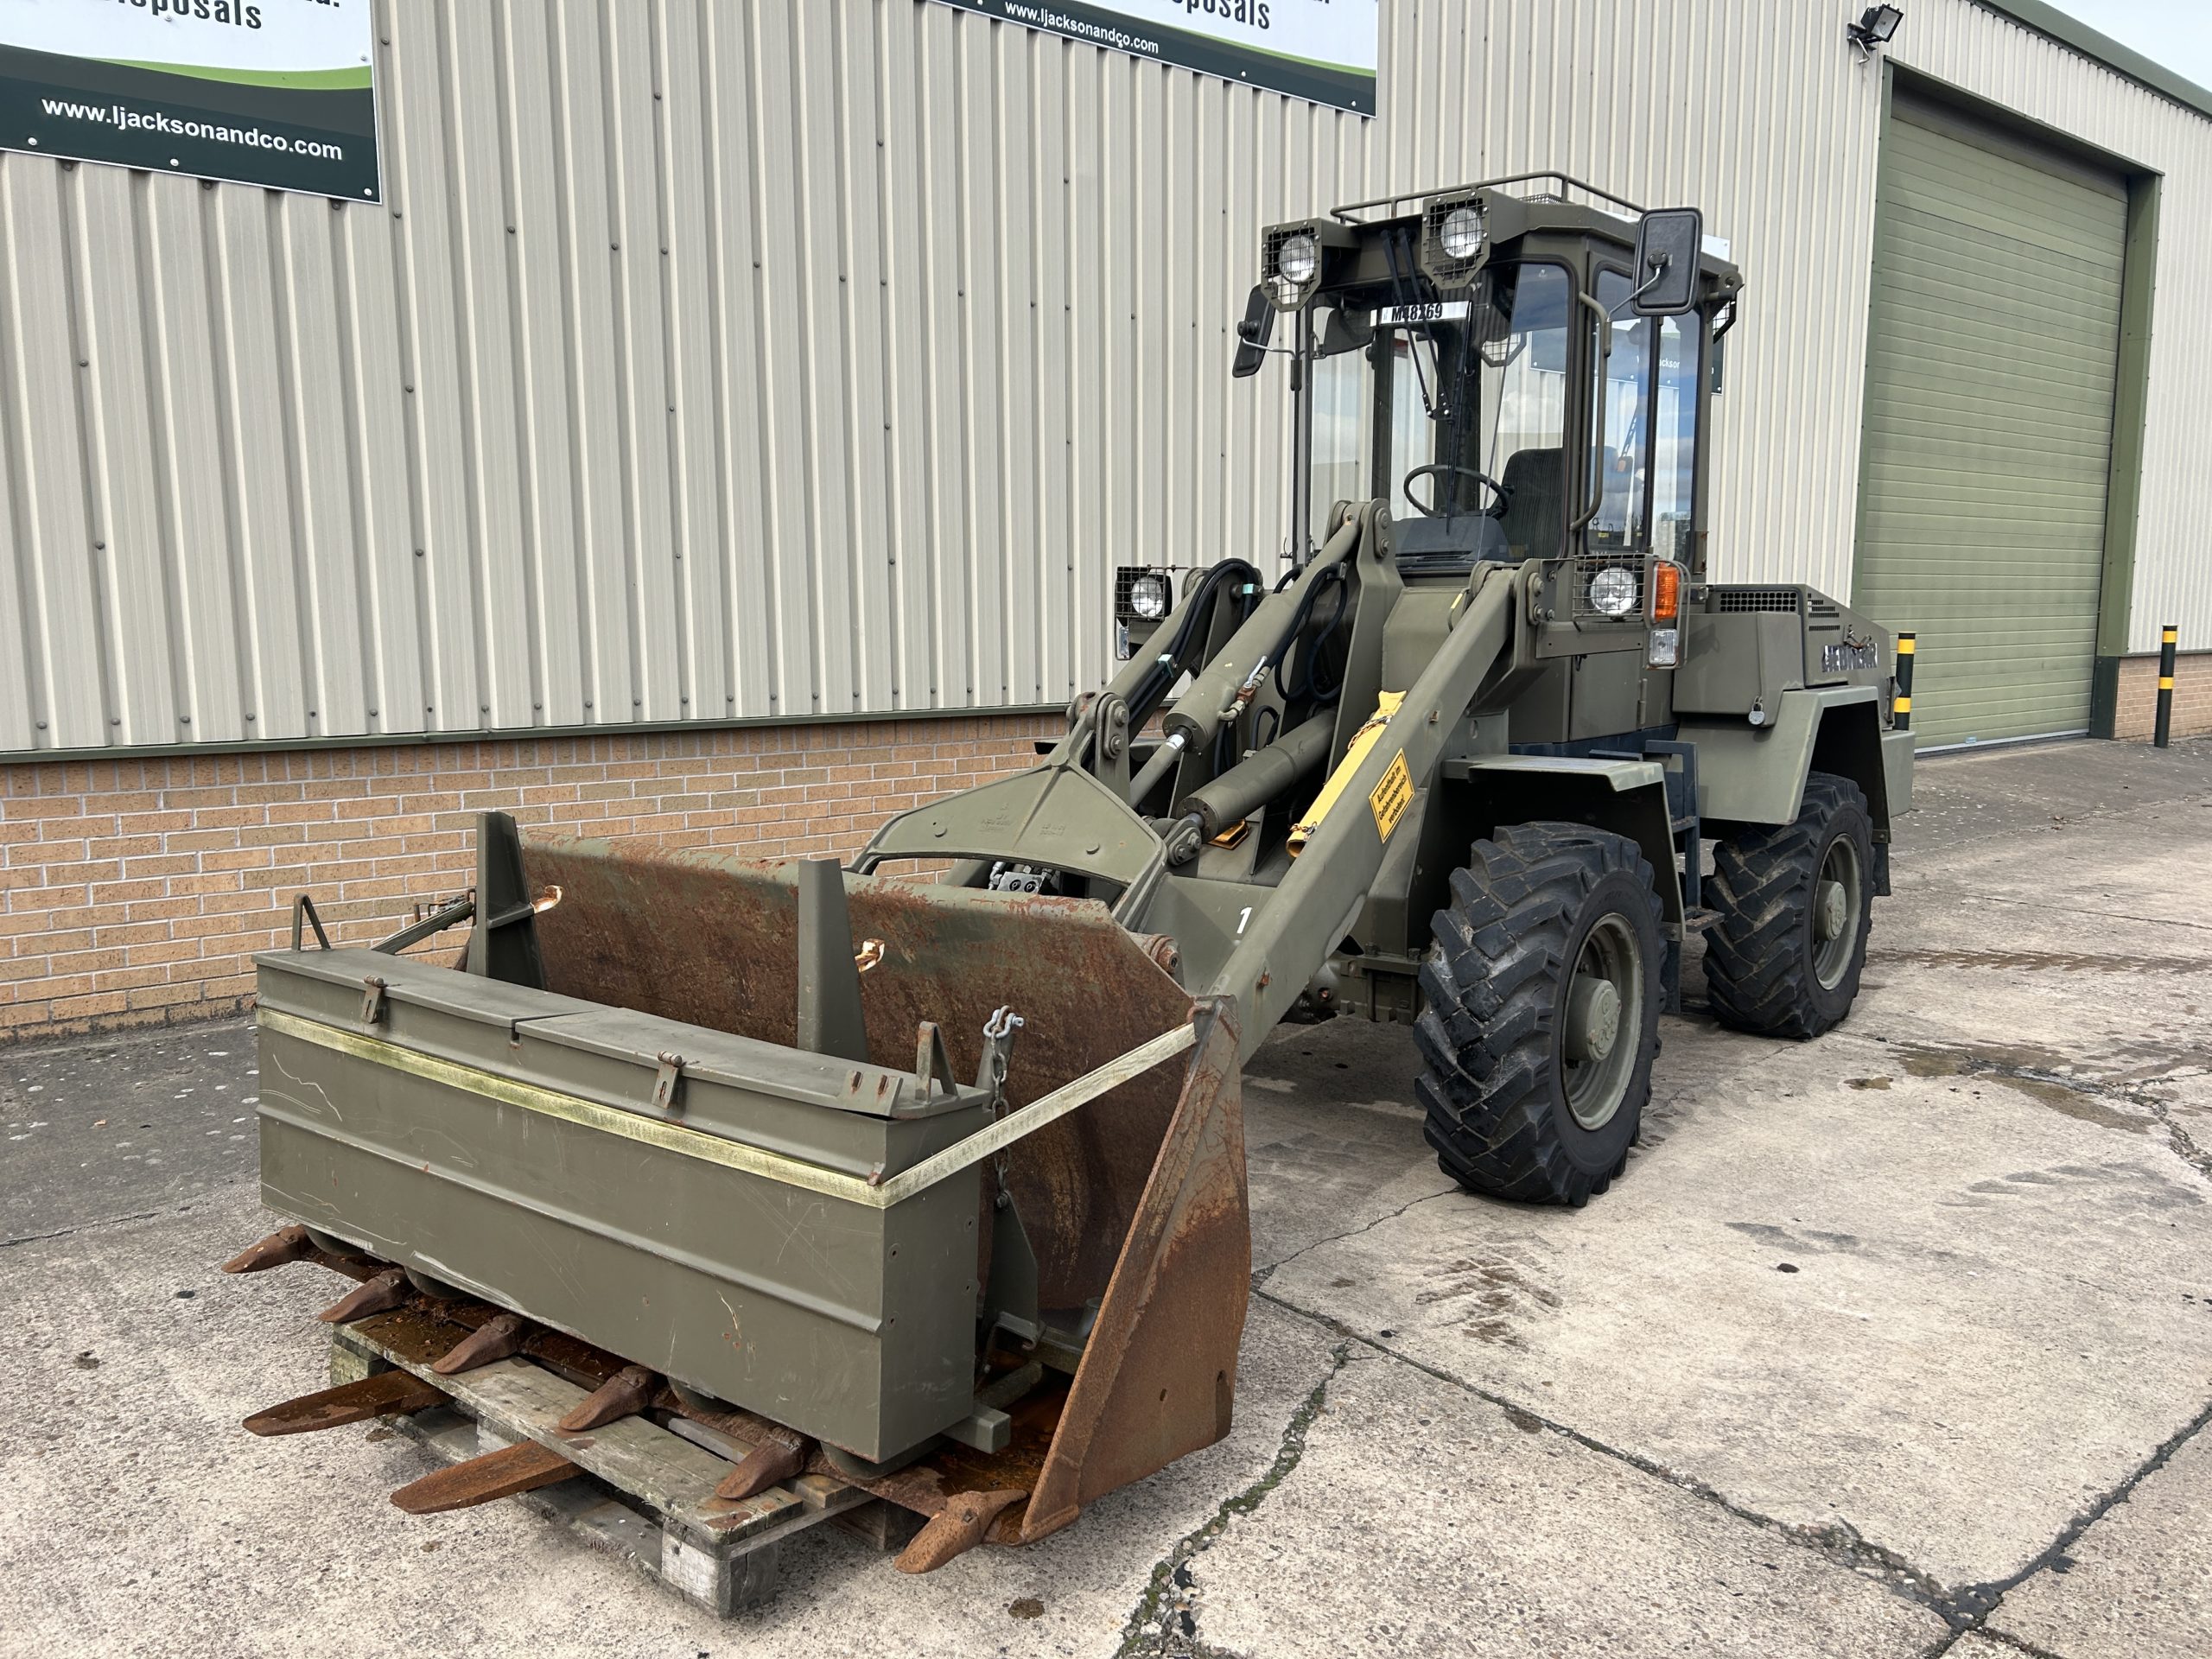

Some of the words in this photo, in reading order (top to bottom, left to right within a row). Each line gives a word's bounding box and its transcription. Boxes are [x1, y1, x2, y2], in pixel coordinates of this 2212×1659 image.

[1005, 2, 1159, 54] www.ljacksonandco.com
[41, 99, 343, 160] www.ljacksonandco.com
[1237, 907, 1252, 933] 1
